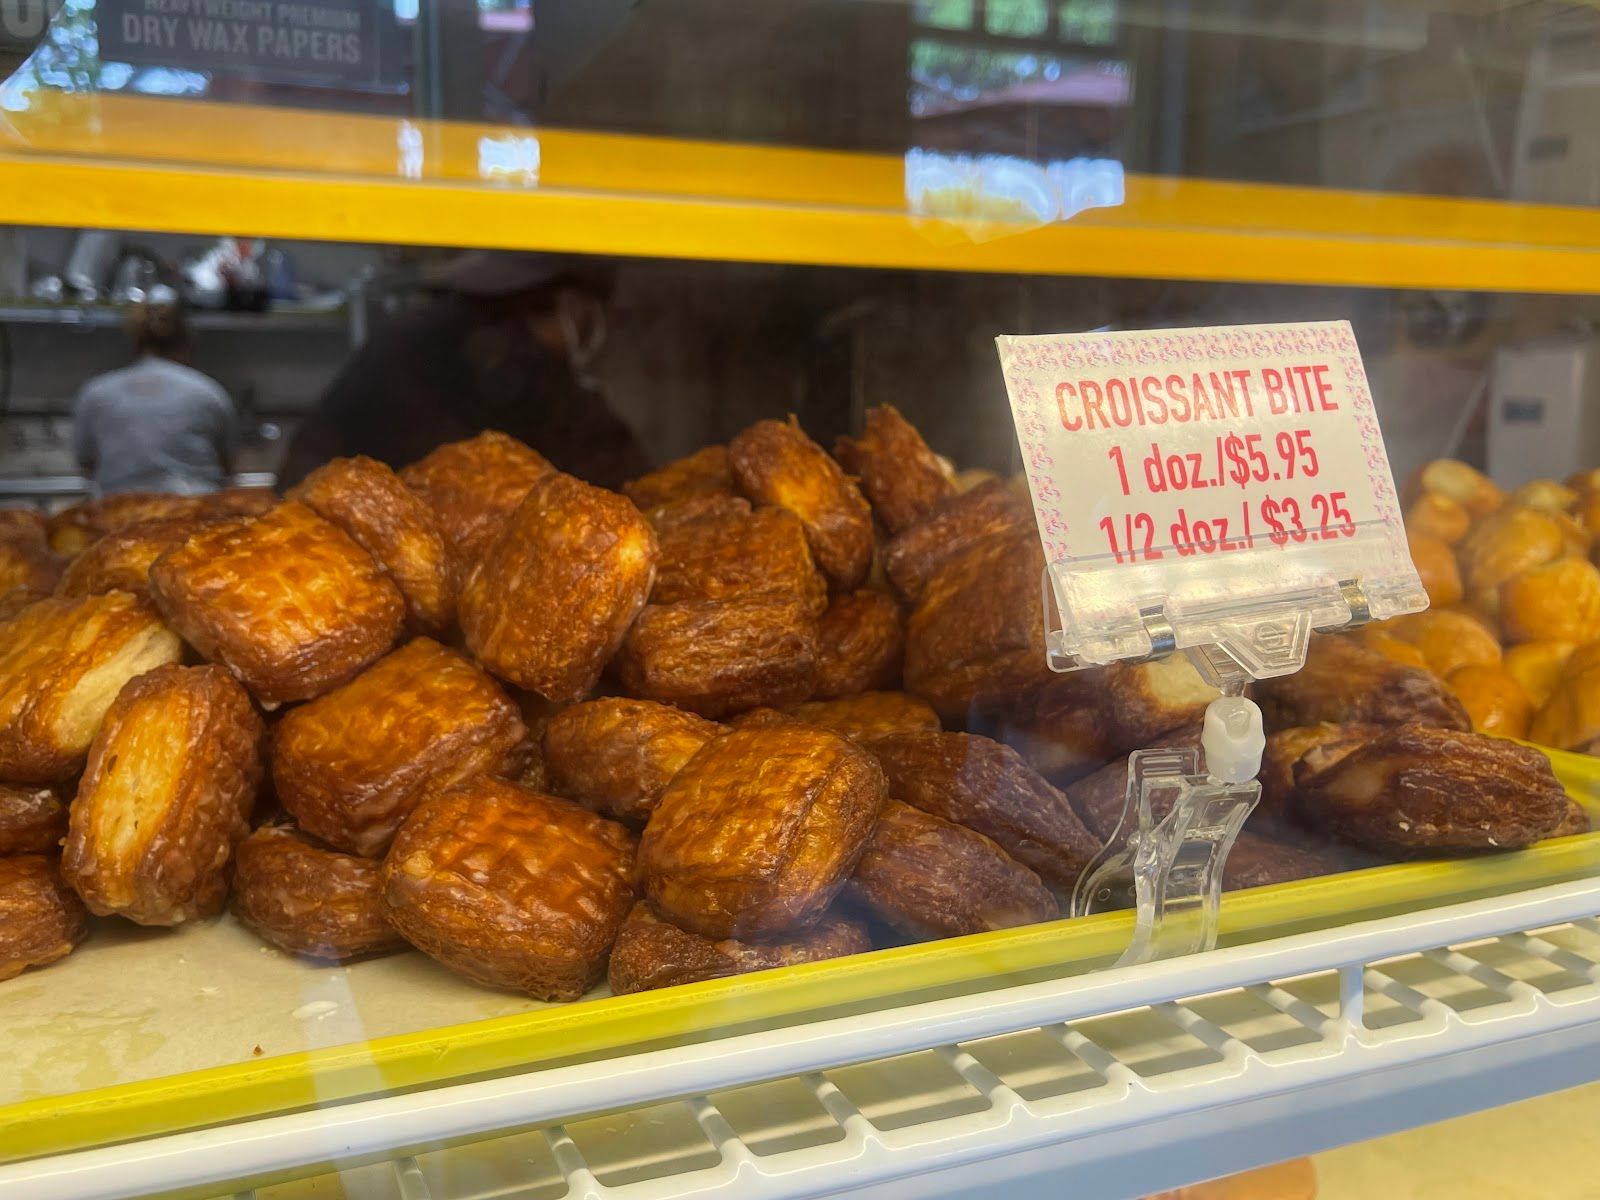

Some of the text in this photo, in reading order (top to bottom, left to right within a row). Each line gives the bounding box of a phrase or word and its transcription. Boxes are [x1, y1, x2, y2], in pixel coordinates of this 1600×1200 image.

[122, 12, 361, 64] DRY WAX PAPERS
[1055, 364, 1339, 432] CROISSANT BITE
[1108, 429, 1320, 497] 1 doz./$5.95
[1099, 512, 1164, 564] 1/2
